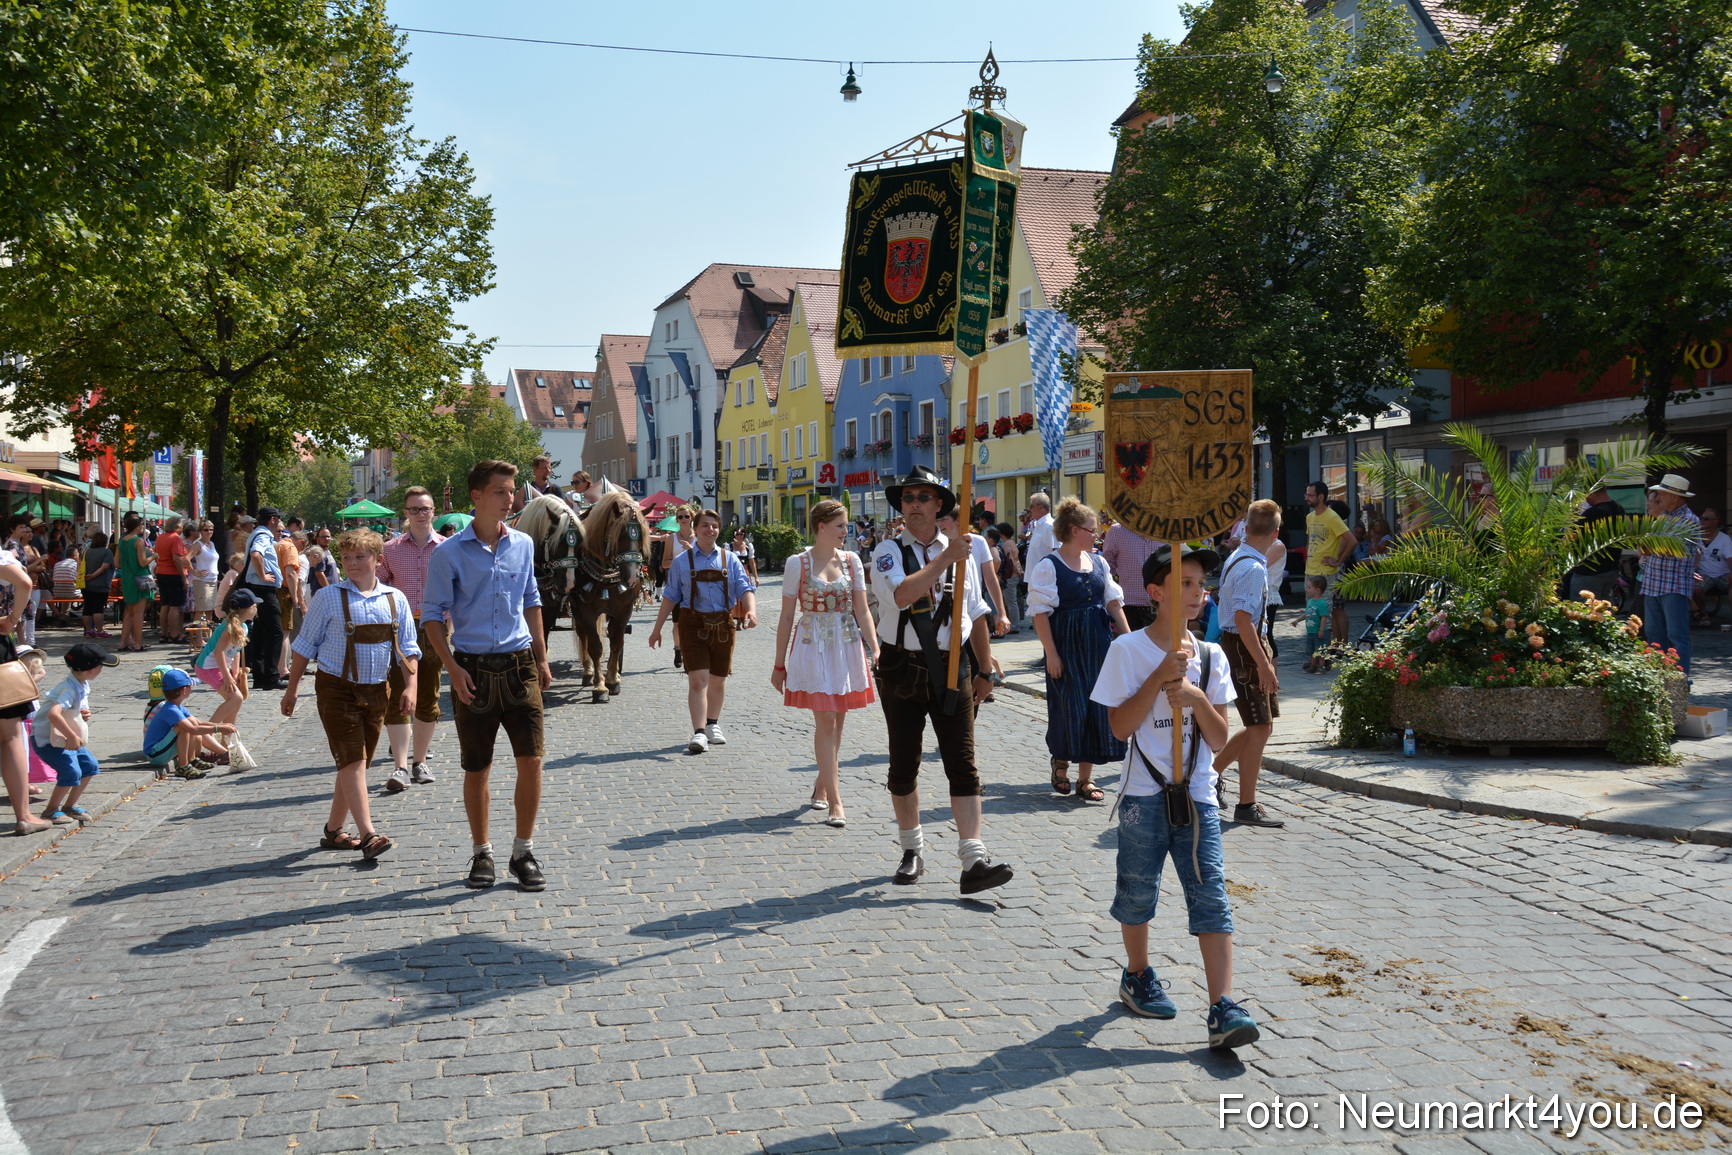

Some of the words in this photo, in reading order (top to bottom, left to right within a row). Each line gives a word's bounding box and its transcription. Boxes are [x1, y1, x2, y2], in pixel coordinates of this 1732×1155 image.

[858, 277, 909, 325] Neumarkt
[741, 419, 755, 432] HOTEL
[1186, 442, 1245, 480] 1433
